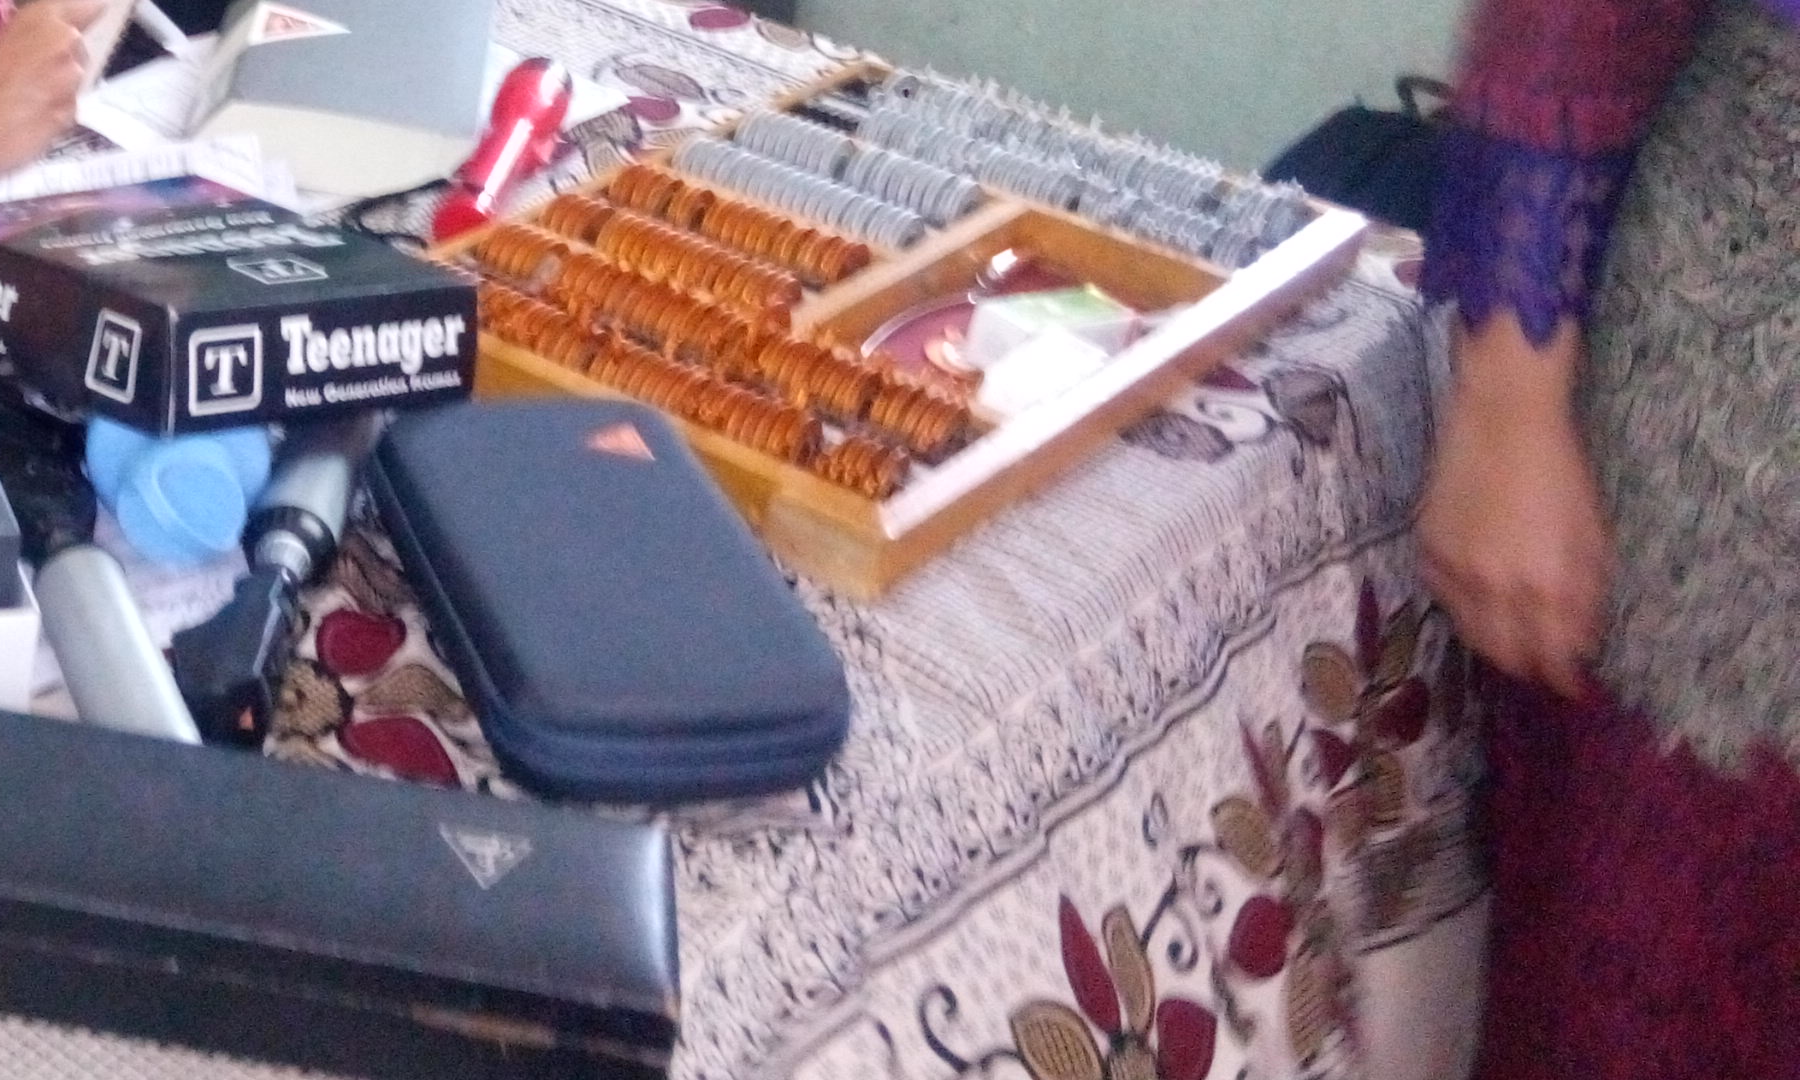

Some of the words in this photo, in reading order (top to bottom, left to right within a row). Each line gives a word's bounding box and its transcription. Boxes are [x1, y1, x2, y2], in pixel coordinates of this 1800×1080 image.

[100, 326, 131, 383] T
[203, 345, 248, 397] T
[280, 313, 466, 375] Teenager
